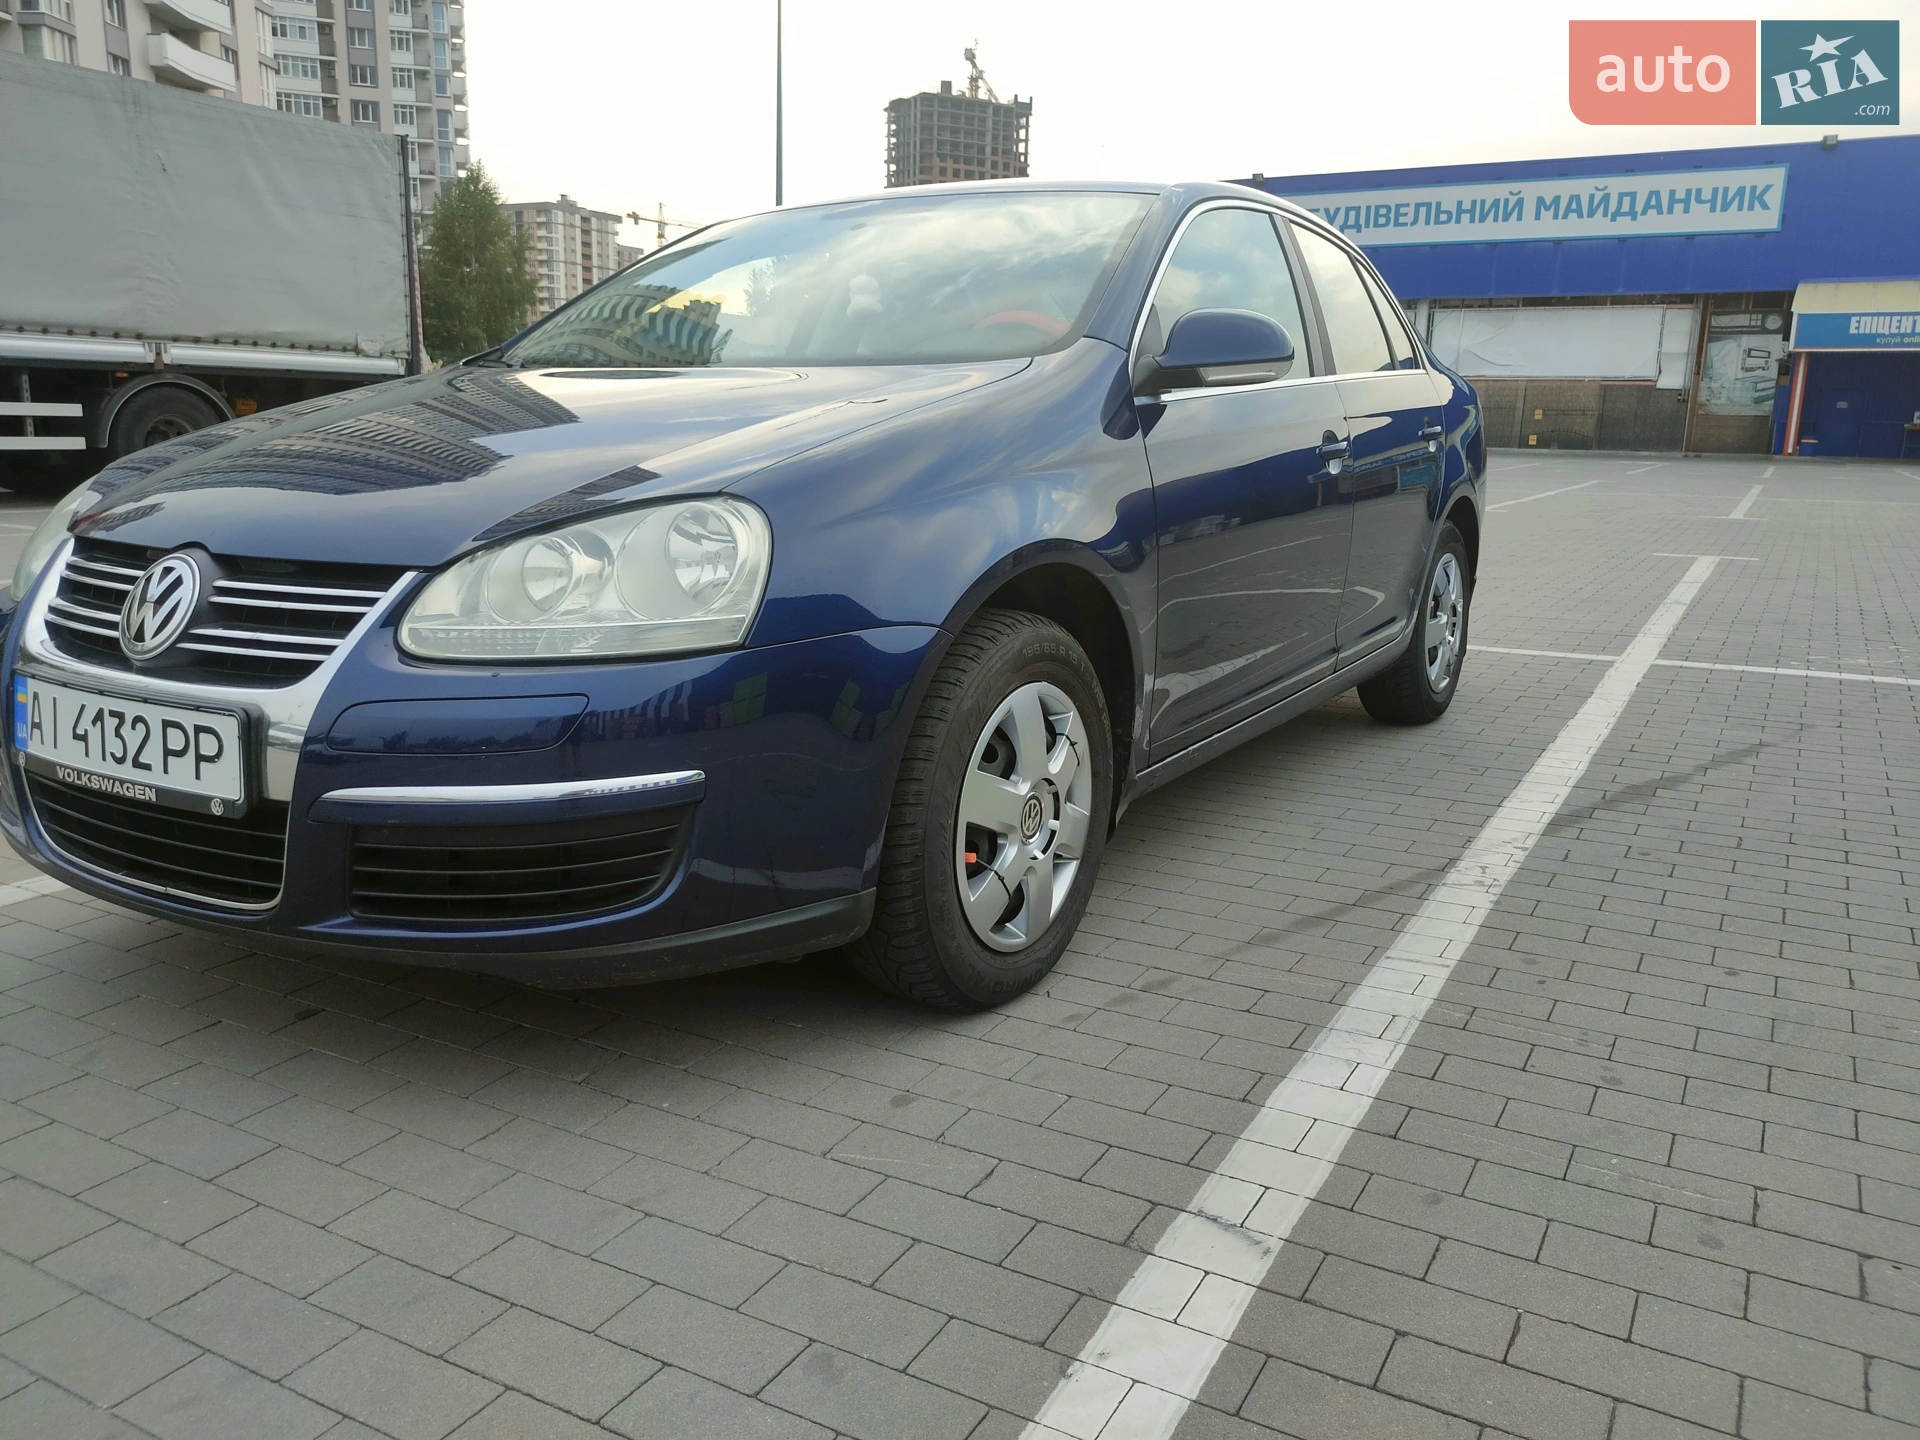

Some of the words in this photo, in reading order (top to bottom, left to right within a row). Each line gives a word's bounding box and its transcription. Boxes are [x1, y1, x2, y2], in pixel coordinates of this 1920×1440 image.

[1534, 184, 1773, 222] МАЙДАНЧИК
[1022, 642, 1057, 659] 195/65
[1059, 644, 1066, 657] R
[1068, 650, 1078, 665] 15
[17, 721, 28, 740] UA
[56, 766, 157, 800] VOLKSWAGEN
